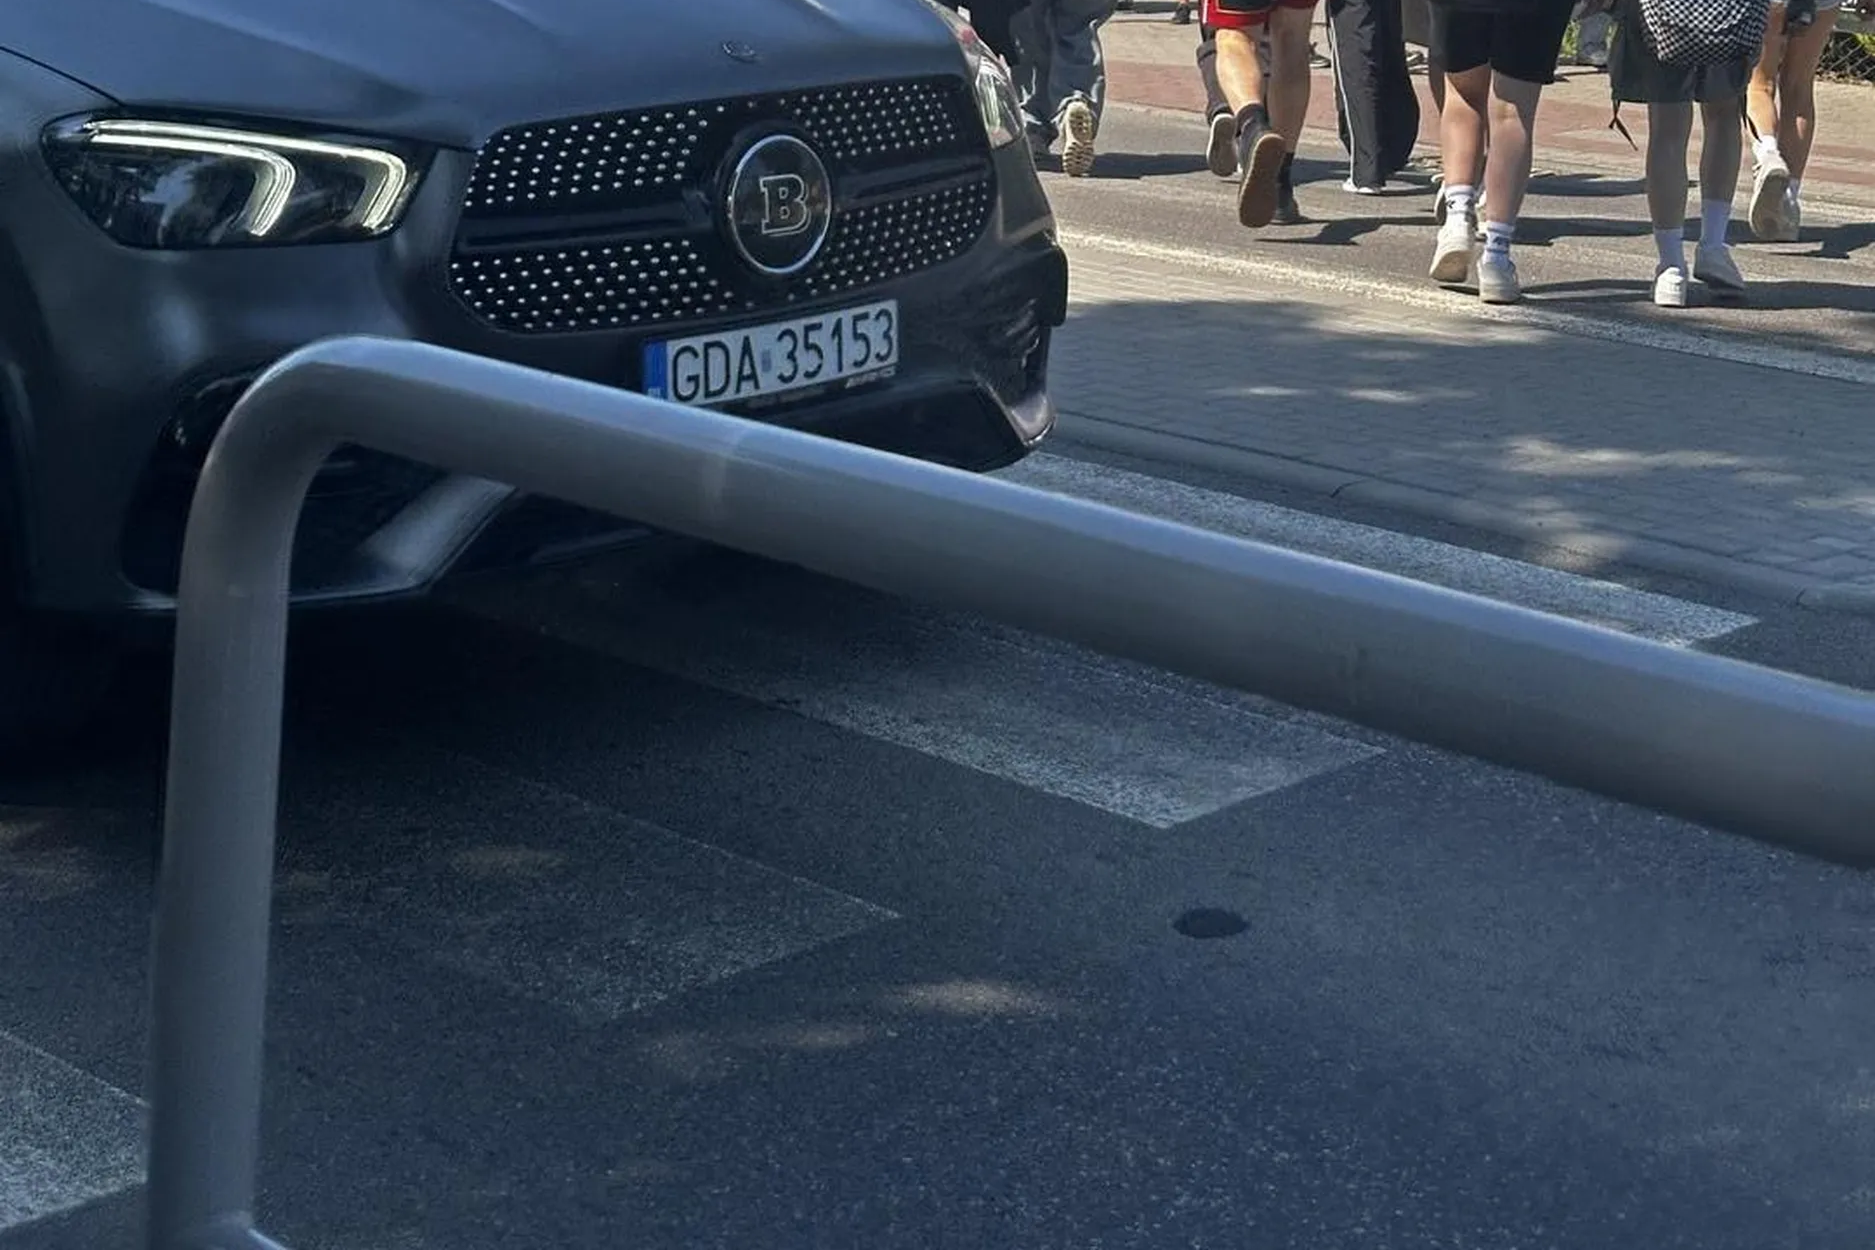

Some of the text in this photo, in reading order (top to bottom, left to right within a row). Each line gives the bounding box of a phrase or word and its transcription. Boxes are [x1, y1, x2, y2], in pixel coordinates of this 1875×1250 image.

[759, 174, 812, 237] B
[672, 308, 895, 401] GDA 35153
